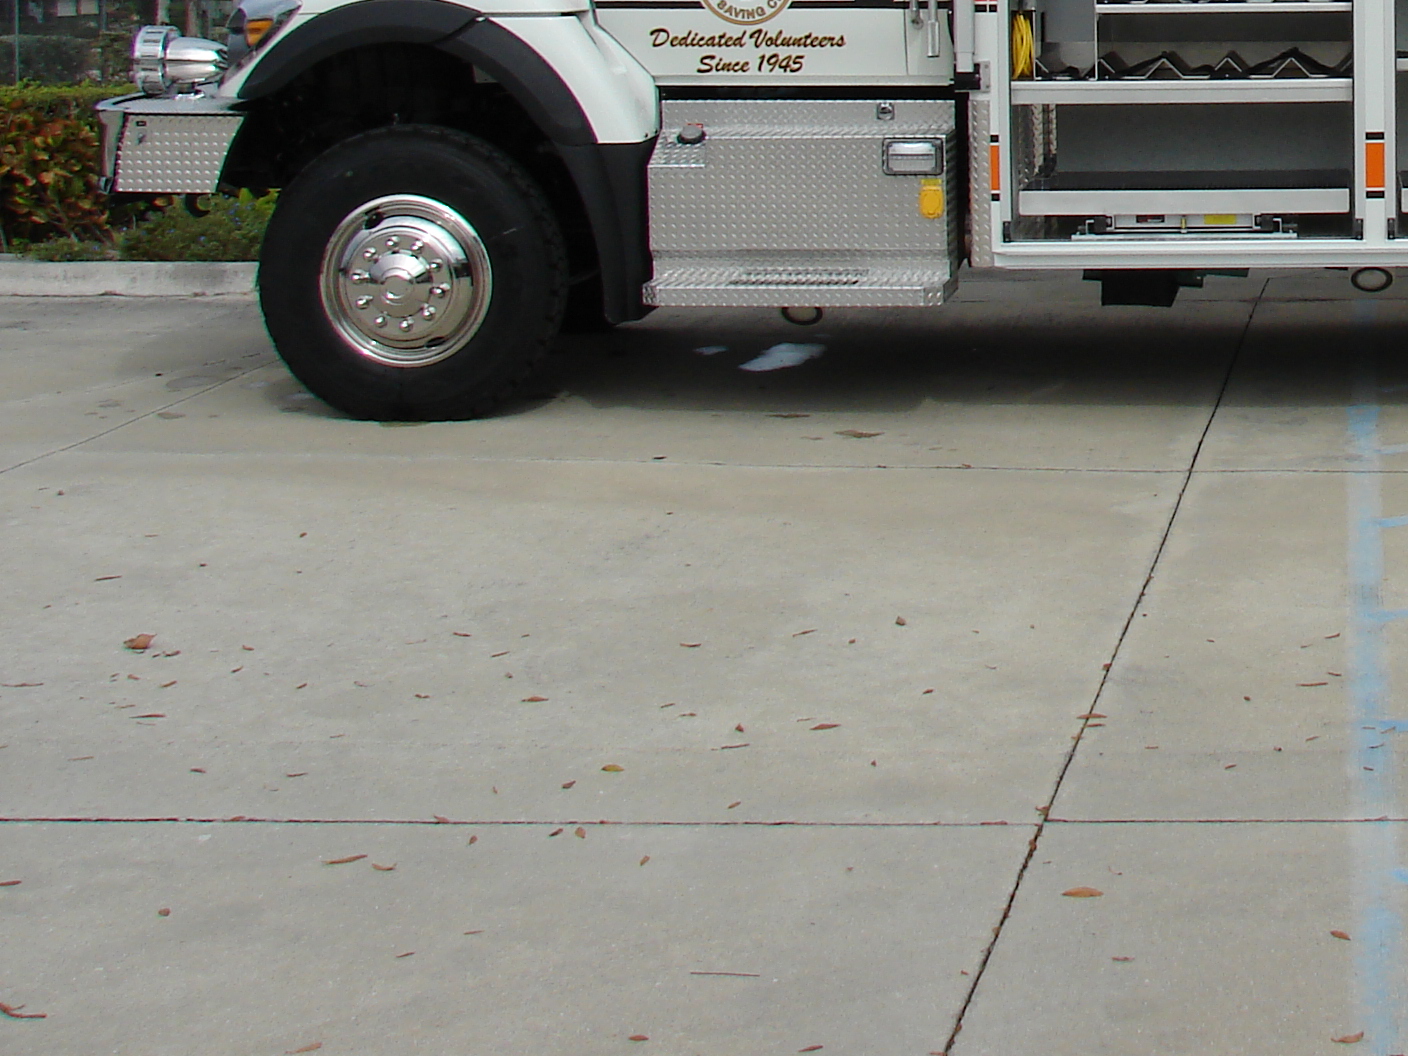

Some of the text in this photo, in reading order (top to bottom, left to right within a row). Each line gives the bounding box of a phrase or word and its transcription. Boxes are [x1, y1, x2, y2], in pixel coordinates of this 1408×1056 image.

[716, 0, 767, 20] SAVING
[650, 28, 846, 48] Dedicated Volunteers
[697, 53, 805, 73] Since 1945
